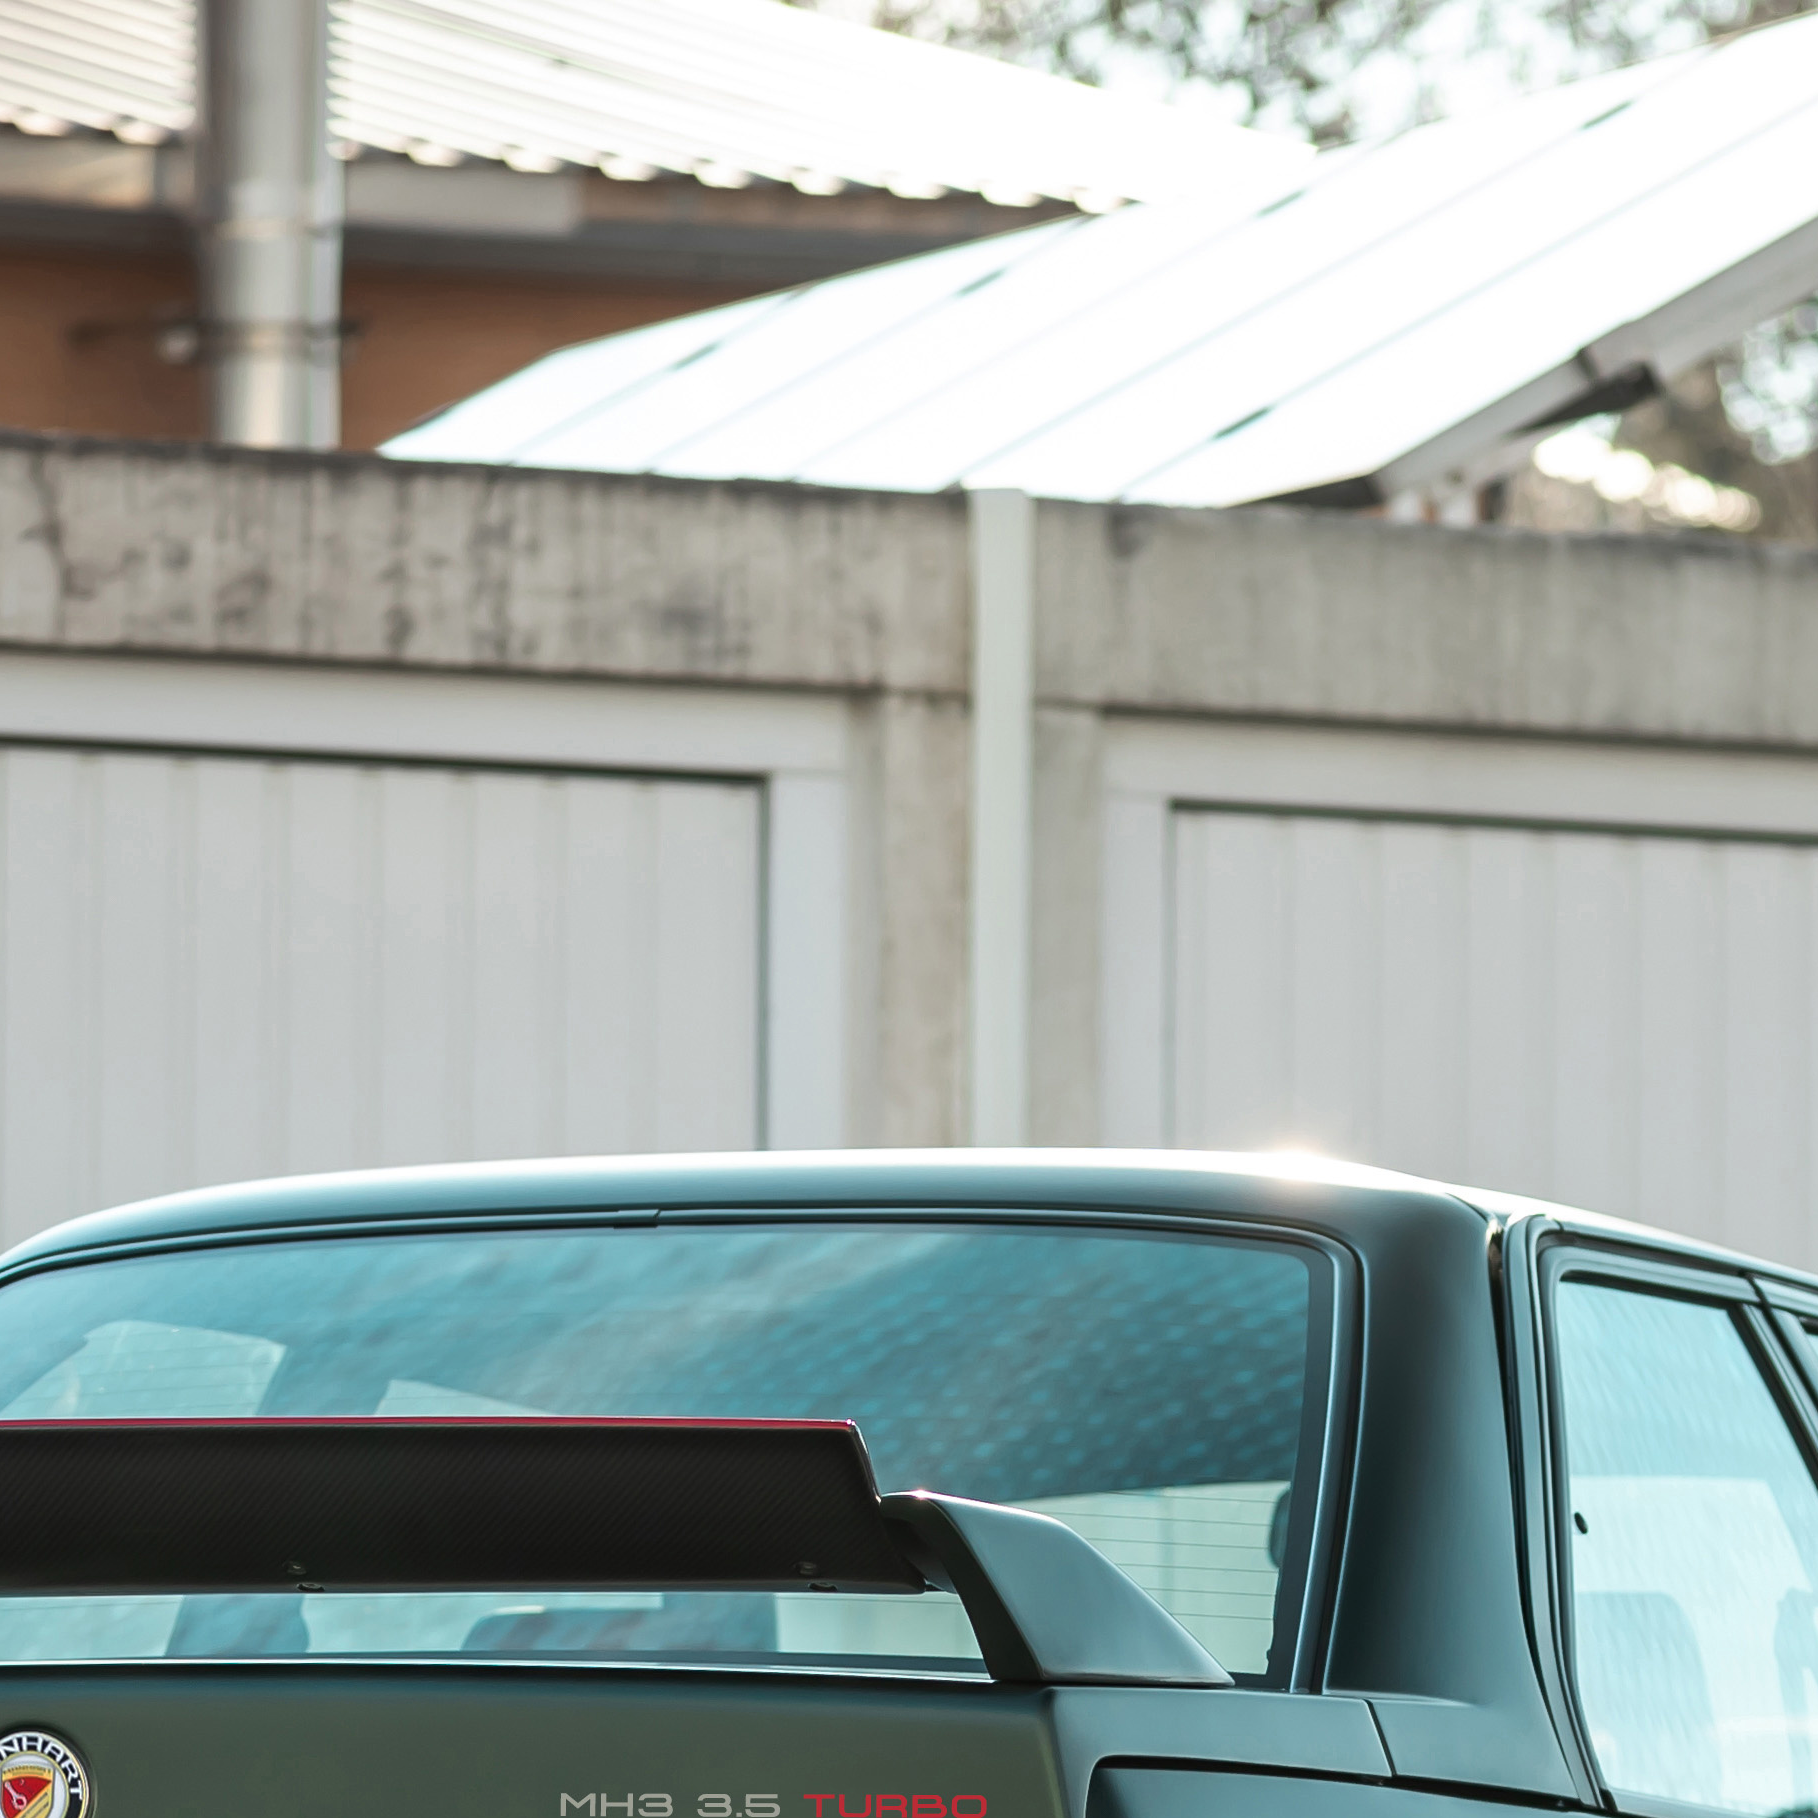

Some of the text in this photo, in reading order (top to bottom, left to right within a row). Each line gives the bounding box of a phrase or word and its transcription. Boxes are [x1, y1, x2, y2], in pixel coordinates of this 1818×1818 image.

[560, 1792, 988, 1818] MH3 3.5 TURBO
